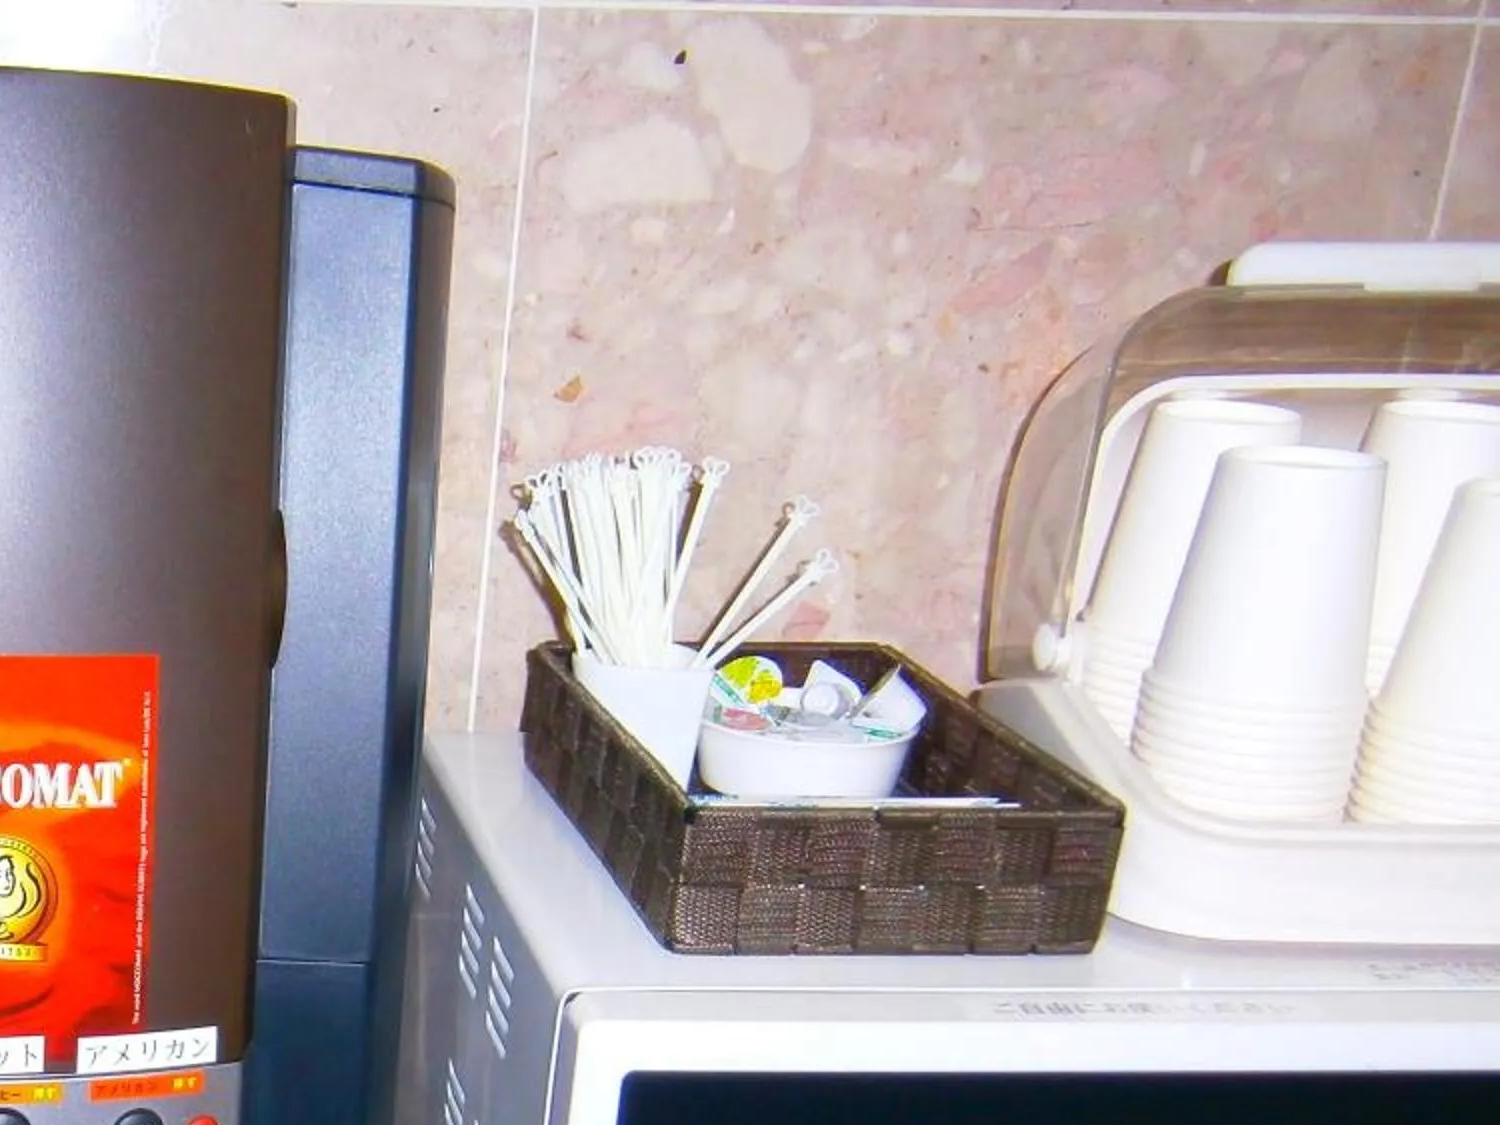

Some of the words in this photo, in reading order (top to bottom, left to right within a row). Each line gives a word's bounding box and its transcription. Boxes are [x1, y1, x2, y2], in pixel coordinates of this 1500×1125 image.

[84, 1036, 210, 1067] アメリカン
